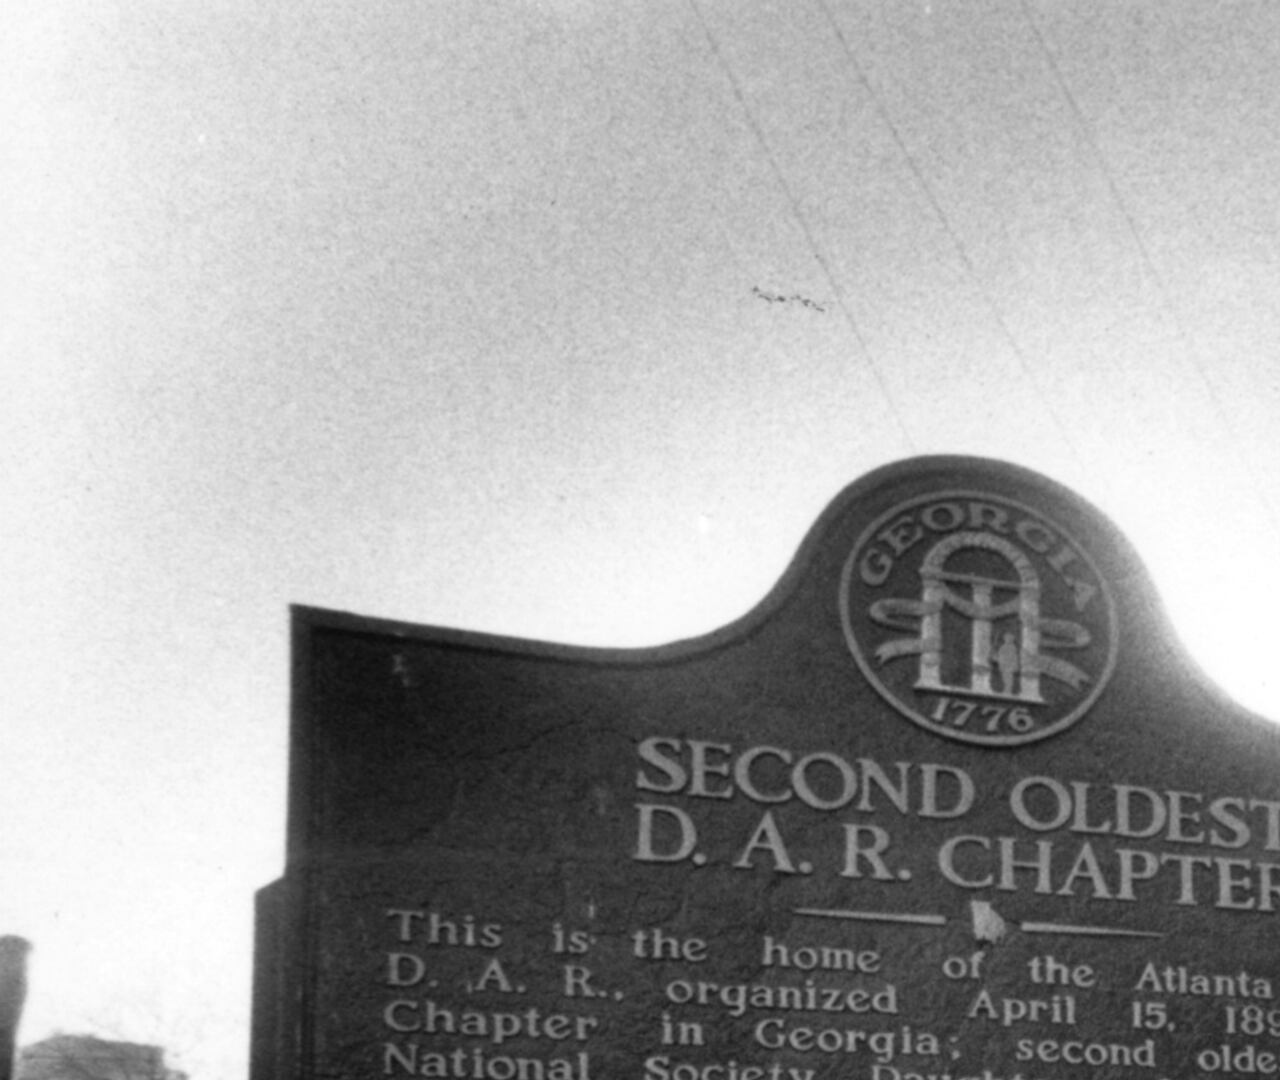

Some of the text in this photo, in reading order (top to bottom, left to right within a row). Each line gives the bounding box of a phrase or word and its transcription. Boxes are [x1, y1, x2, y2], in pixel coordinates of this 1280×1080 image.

[858, 501, 1099, 610] GEORGIA
[930, 698, 1034, 733] 1776
[636, 737, 975, 817] SECOND
[634, 803, 707, 865] D.
[734, 811, 812, 873] A.
[841, 823, 912, 880] R.
[387, 909, 503, 947] This
[553, 922, 589, 953] is
[632, 928, 706, 961] the
[762, 936, 880, 972] home
[942, 951, 985, 978] of
[1028, 955, 1095, 987] the
[1135, 961, 1272, 998] Atlanta
[388, 952, 438, 987] D.
[476, 958, 526, 993] A.
[666, 979, 898, 1016] organized
[968, 989, 1075, 1026] April
[384, 1000, 598, 1044] Chapter
[662, 1013, 703, 1045] in
[754, 1019, 961, 1063] Georgia;
[1015, 1038, 1155, 1067] second
